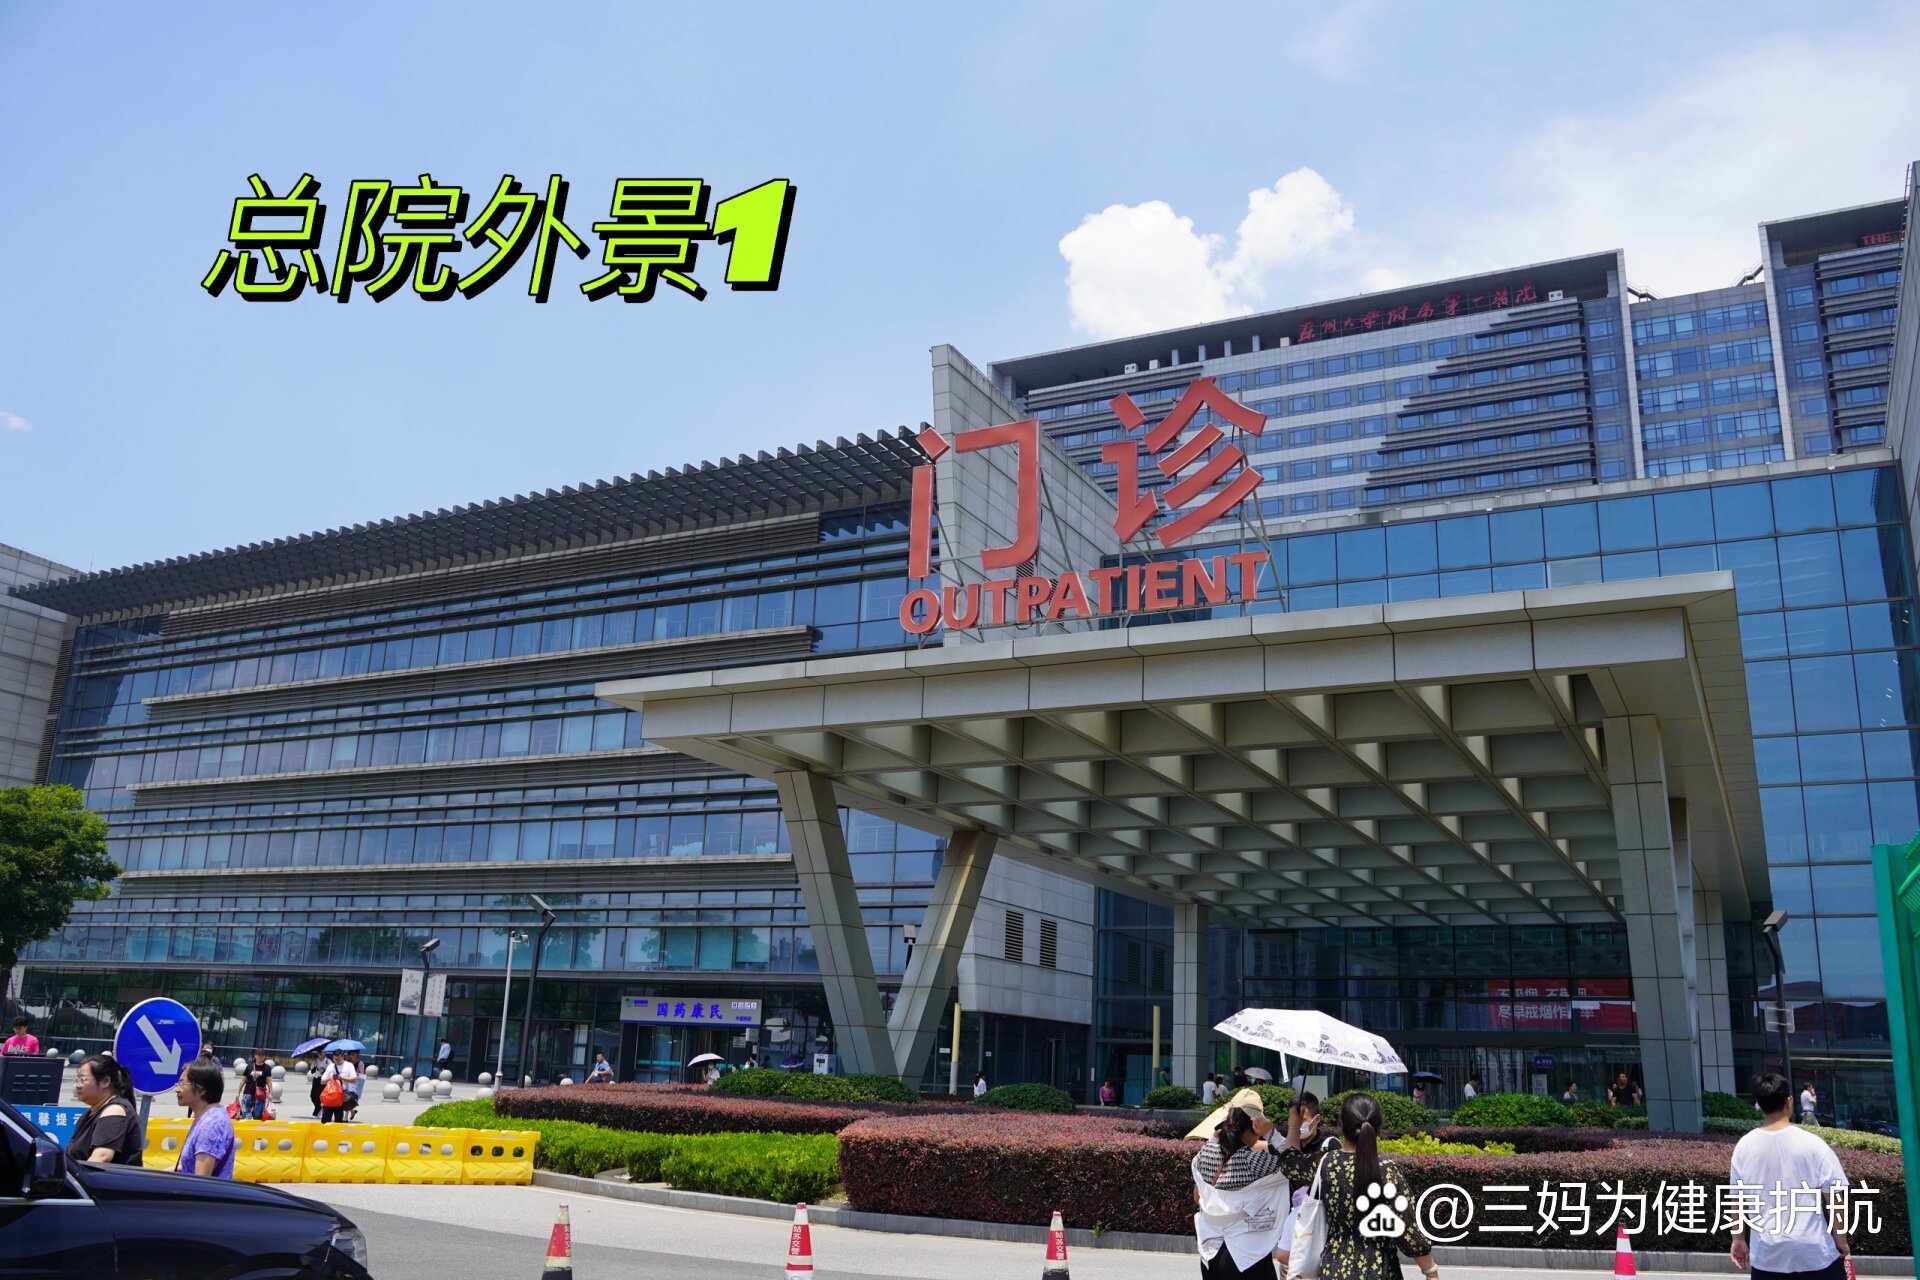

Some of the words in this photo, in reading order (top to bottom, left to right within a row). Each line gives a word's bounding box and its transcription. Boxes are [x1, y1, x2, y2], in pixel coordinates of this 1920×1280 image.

[908, 376, 1268, 579] 门诊
[899, 551, 1269, 635] OUTPATIENT
[656, 1002, 723, 1020] 国药康民
[1497, 1004, 1595, 1020] 尽早戒烟作率
